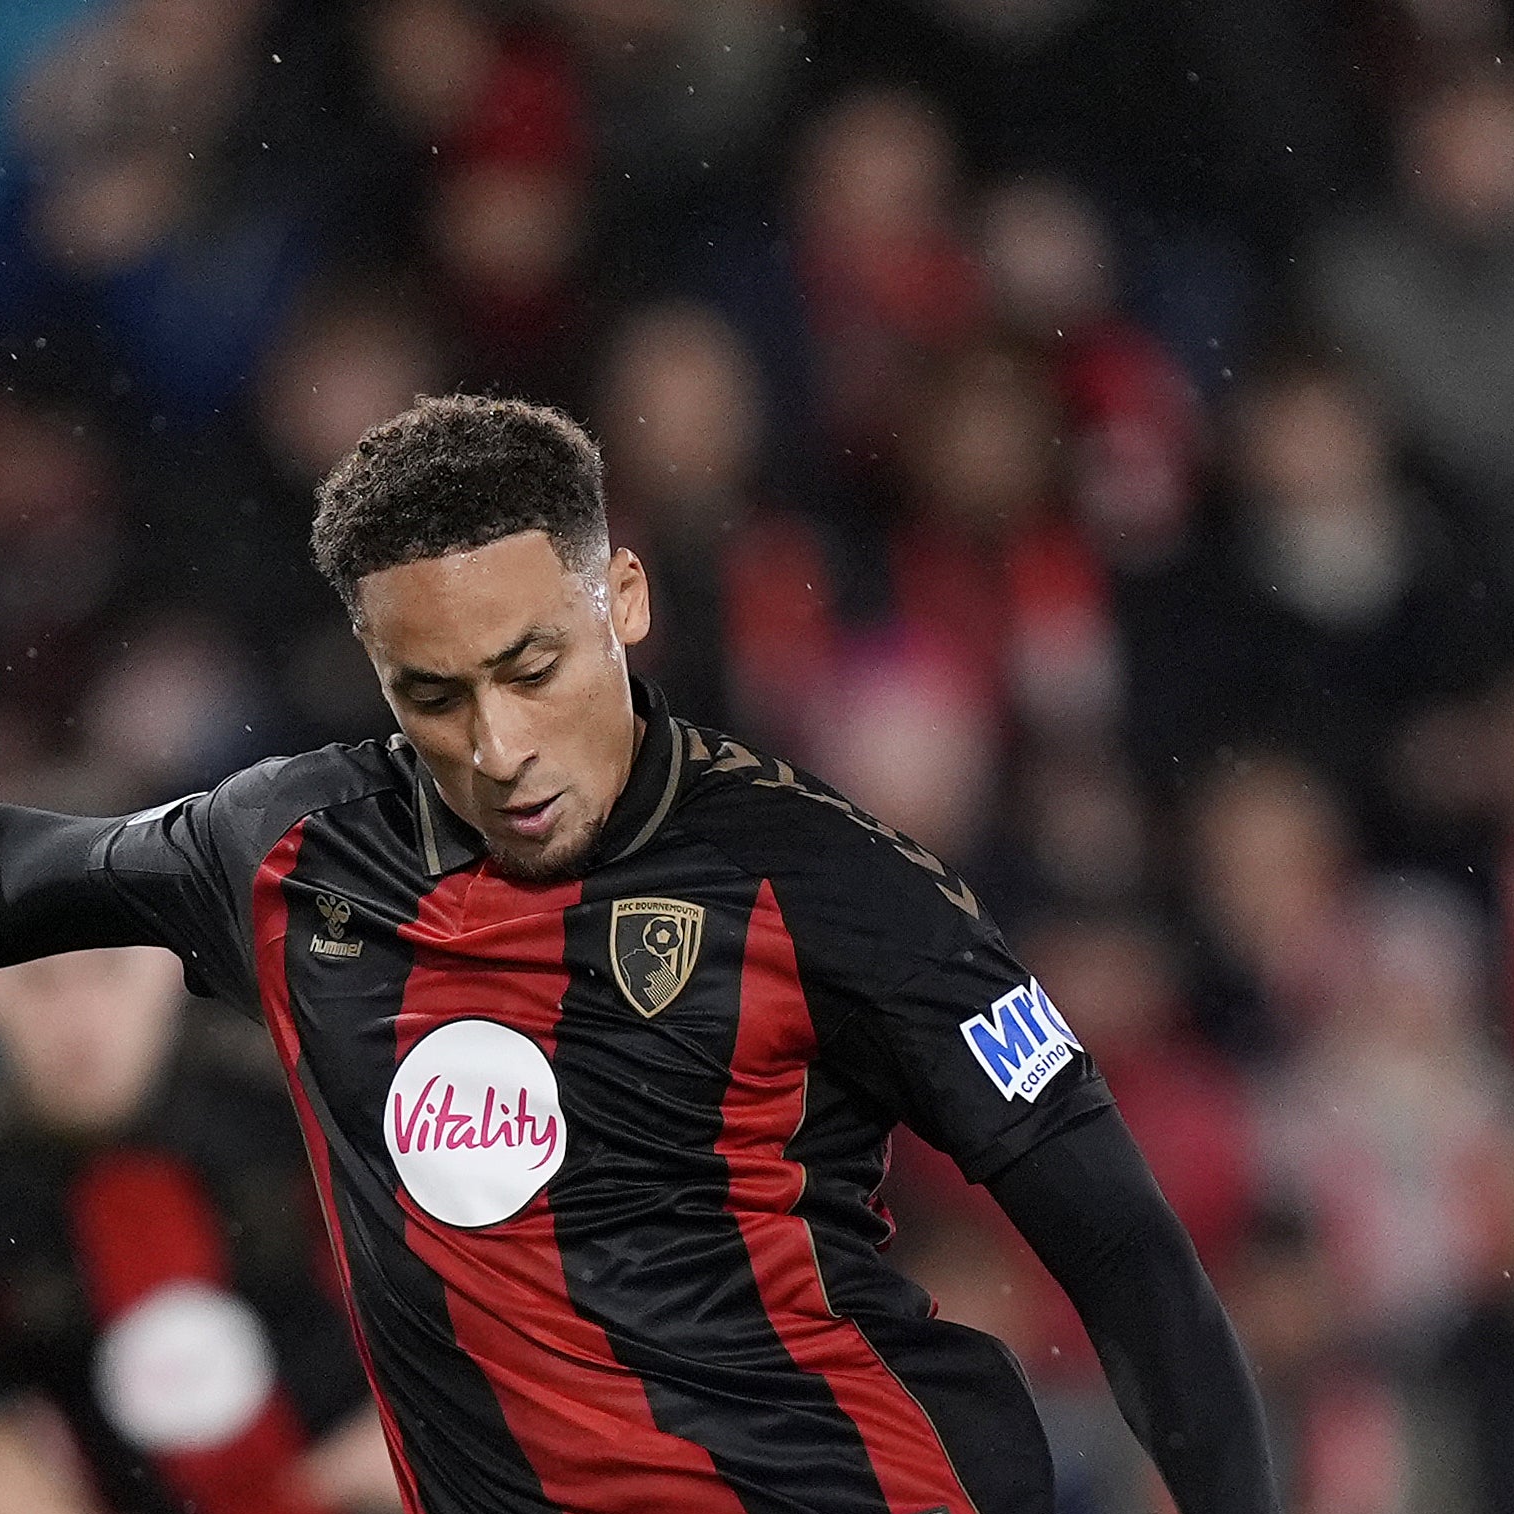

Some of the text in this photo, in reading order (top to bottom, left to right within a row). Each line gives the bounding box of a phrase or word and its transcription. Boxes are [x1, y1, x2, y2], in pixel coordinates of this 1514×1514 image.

[617, 902, 699, 917] AFC BOURNEMOUTH
[310, 934, 364, 958] hummel
[1021, 1044, 1066, 1093] casino
[394, 1075, 557, 1171] Vitality
